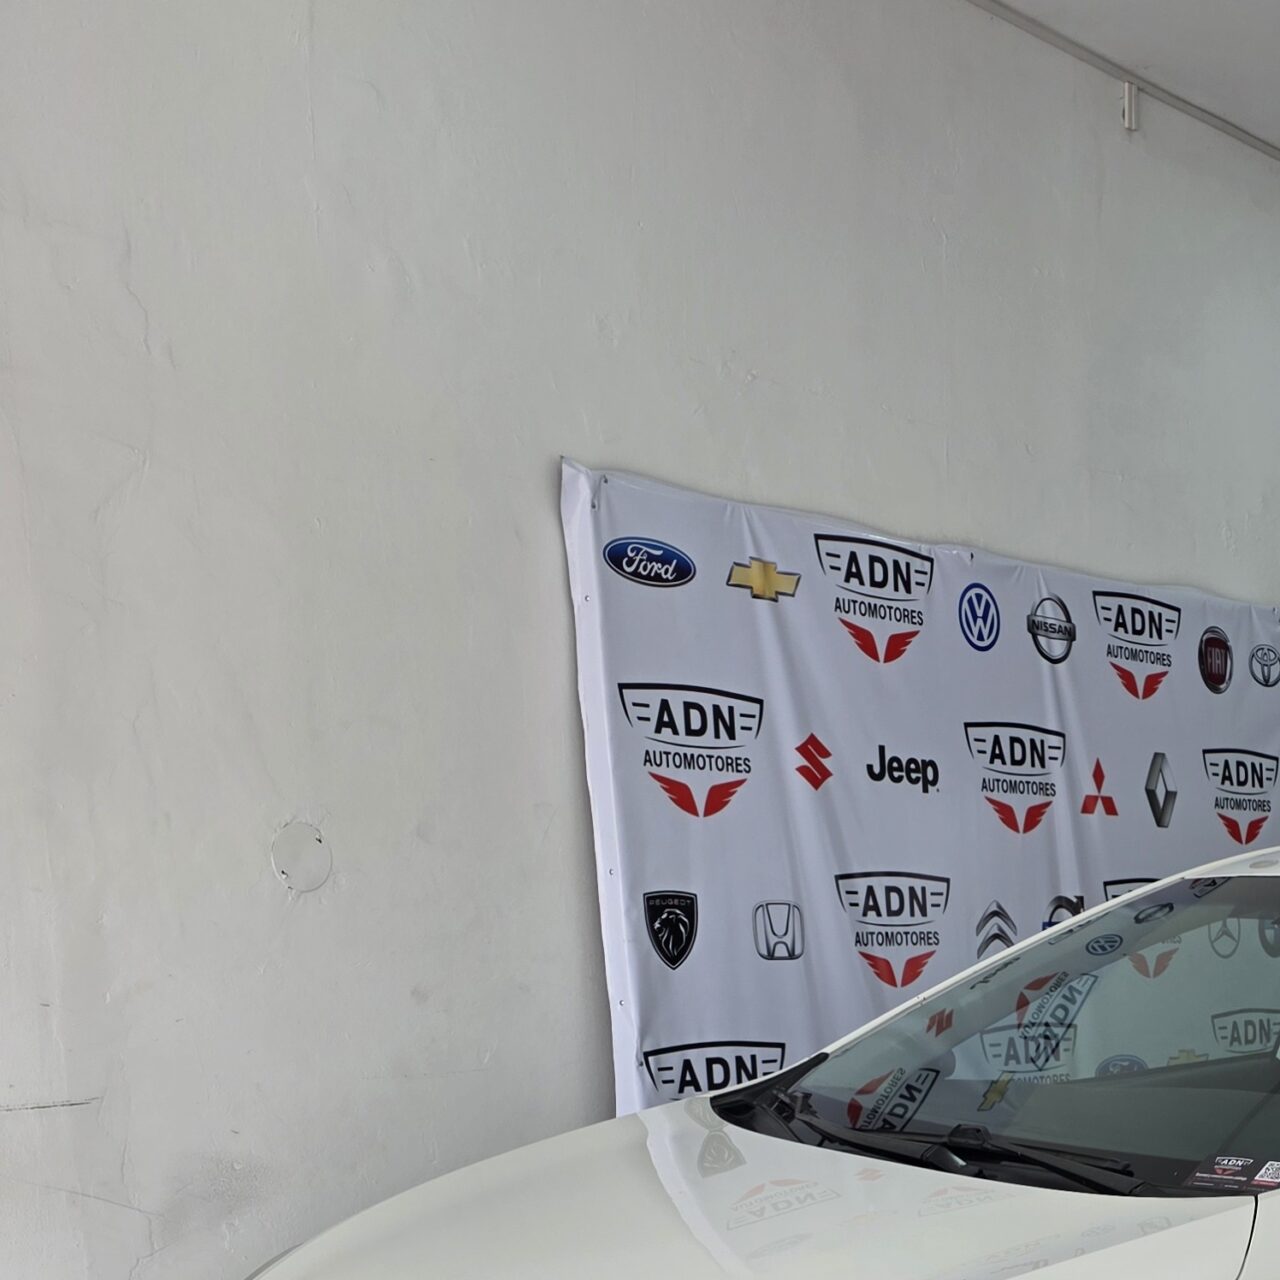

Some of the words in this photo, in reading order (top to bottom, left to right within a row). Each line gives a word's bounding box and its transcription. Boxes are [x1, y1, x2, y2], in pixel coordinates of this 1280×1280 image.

[622, 542, 678, 582] Ford
[843, 550, 913, 595] ADN
[834, 597, 924, 627] AUTOMOTORES
[1113, 604, 1163, 641] ADN
[1031, 617, 1073, 638] NISSAN
[1106, 643, 1172, 668] AUTOMOTORES
[1206, 645, 1226, 675] FIAT
[653, 698, 737, 741] ADN
[643, 748, 752, 775] AUTOMOTORES
[988, 734, 1047, 770] ADN
[866, 743, 940, 793] Jeep
[1220, 760, 1265, 789] ADN
[981, 777, 1057, 798] AUTOMOTORES
[1214, 795, 1272, 814] AUTOMOTORES
[649, 898, 692, 906] PEUGEOT
[861, 884, 928, 919] ADN
[854, 930, 940, 948] AUTOMOTORES
[1229, 1017, 1273, 1048] ADN
[677, 1053, 758, 1094] ADN
[1220, 1159, 1244, 1167] ADN
